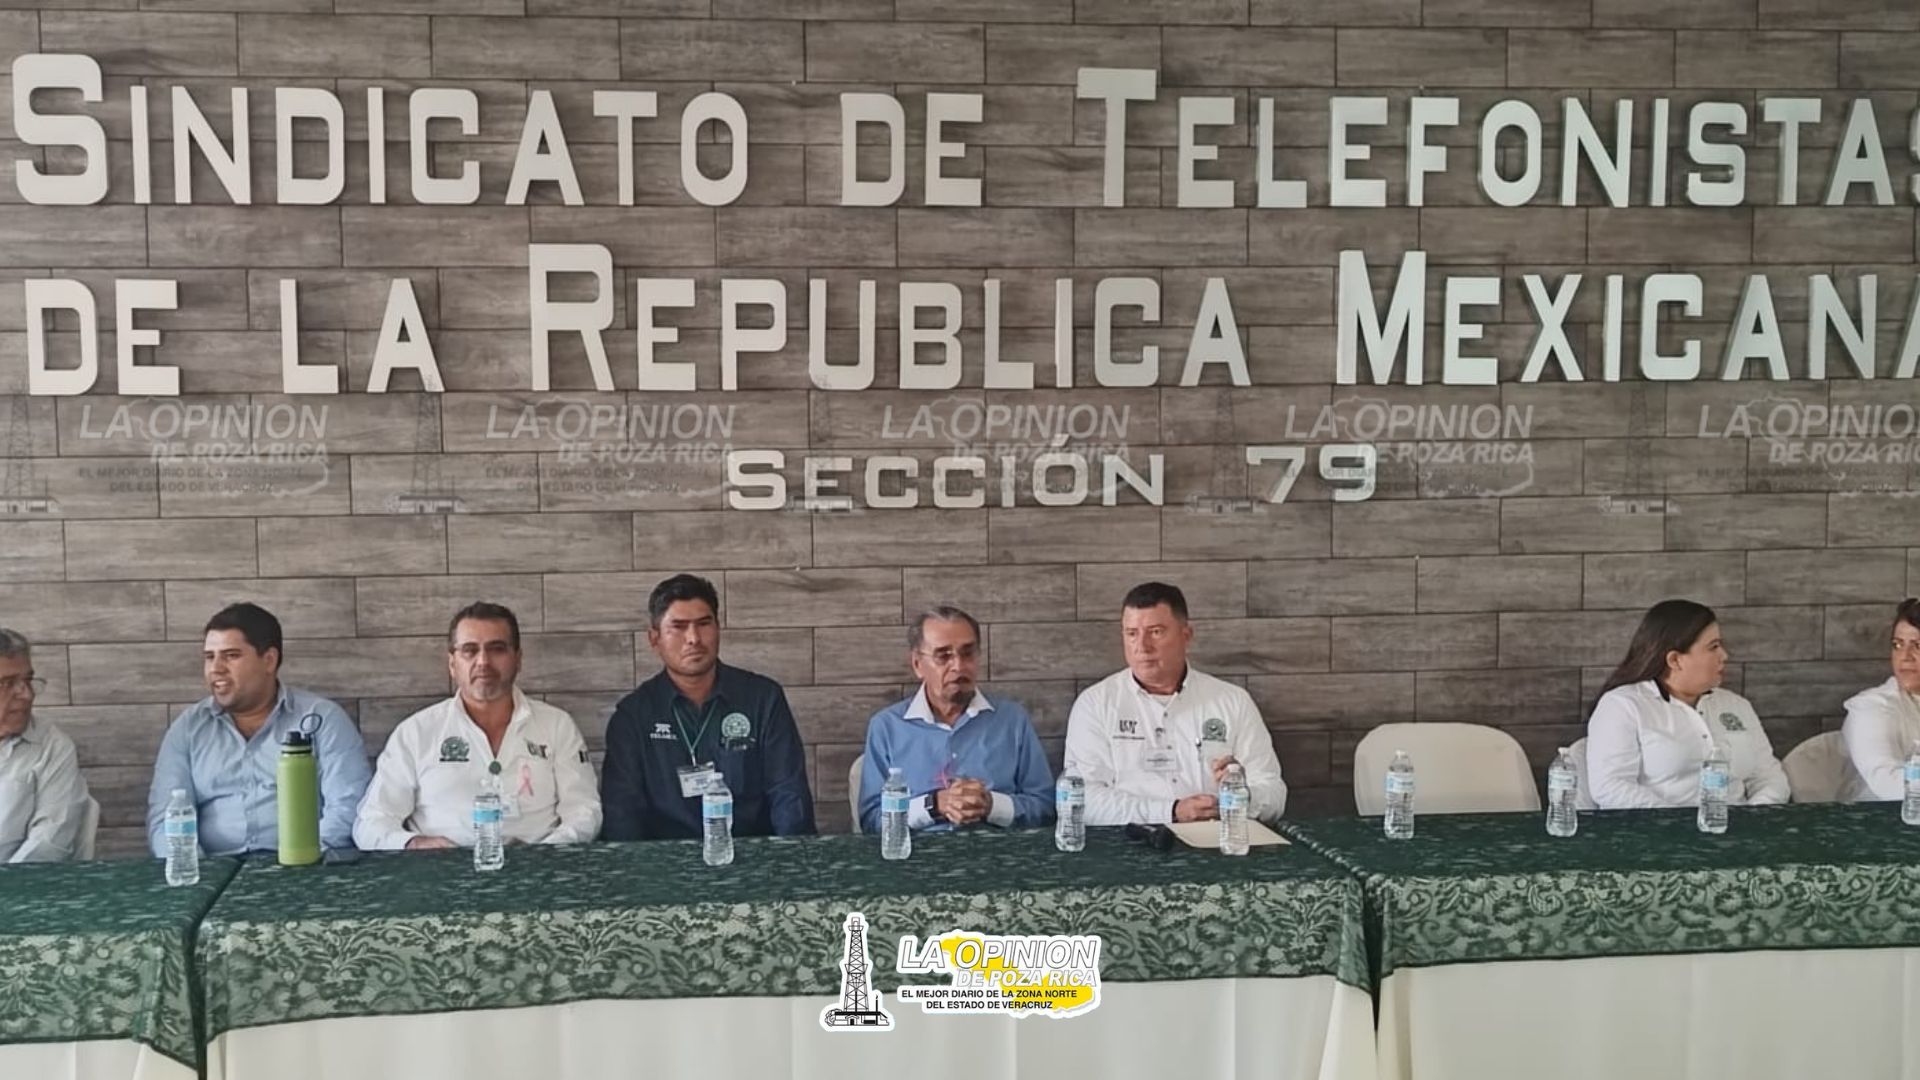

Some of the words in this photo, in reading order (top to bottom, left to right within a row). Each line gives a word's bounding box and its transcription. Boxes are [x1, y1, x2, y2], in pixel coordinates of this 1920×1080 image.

[12, 53, 748, 206] SINDICATO
[841, 93, 983, 206] DE
[25, 278, 181, 397] DE
[280, 278, 446, 394] LA
[529, 242, 1252, 392] REPUBLICA
[727, 433, 1164, 510] SECCIÓN
[1245, 443, 1377, 504] 79
